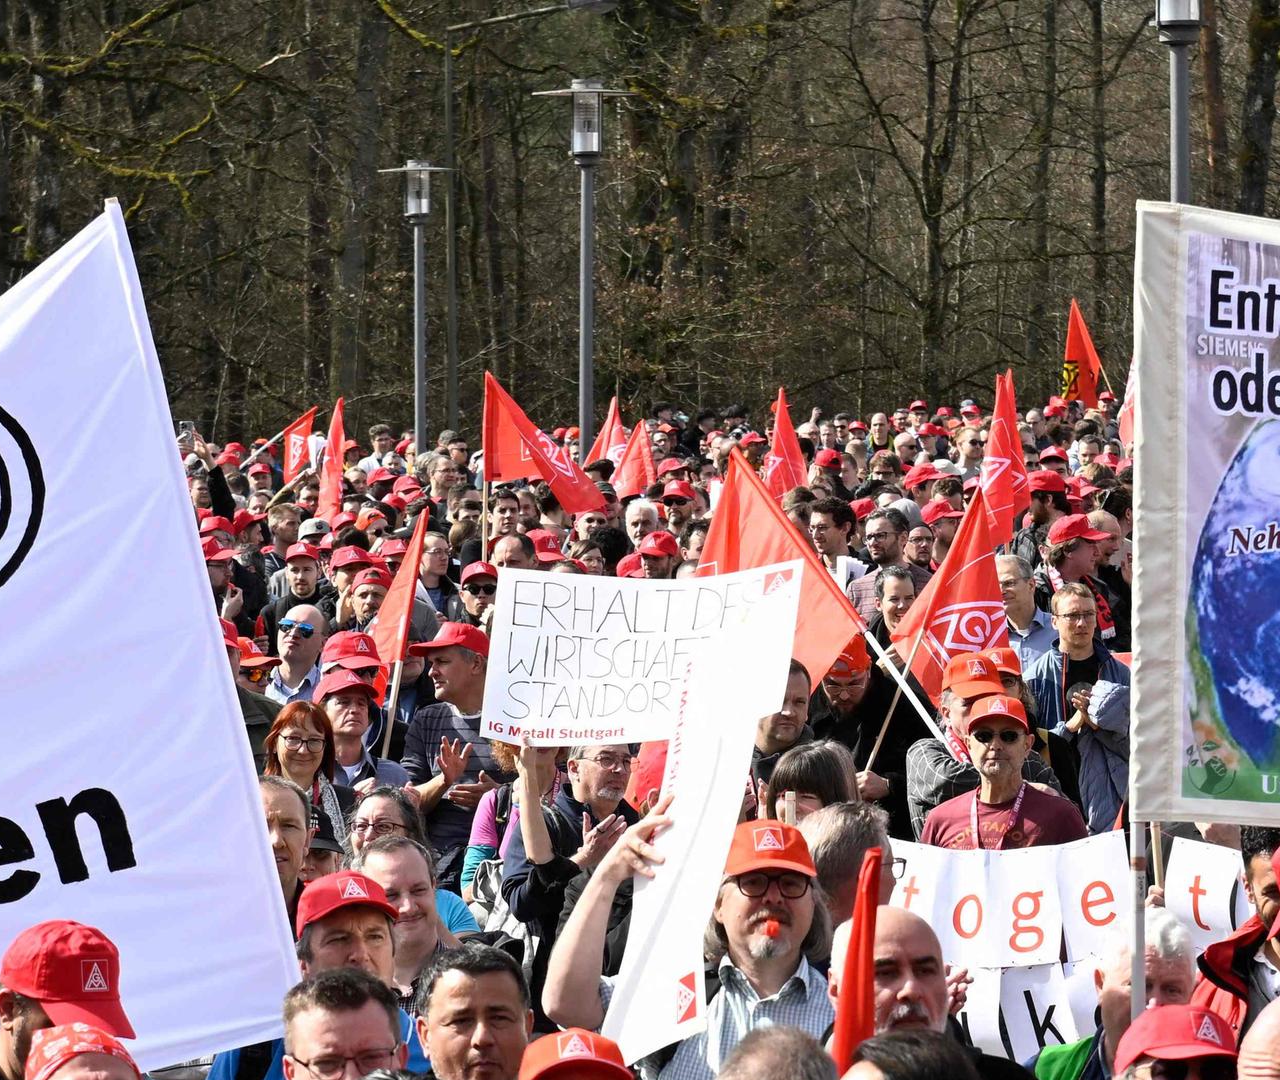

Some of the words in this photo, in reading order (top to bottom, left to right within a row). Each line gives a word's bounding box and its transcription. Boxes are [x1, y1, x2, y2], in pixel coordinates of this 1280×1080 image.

[511, 579, 688, 634] ERHALT
[488, 720, 504, 734] IG
[507, 722, 555, 739] Metall
[559, 726, 626, 740] Stuttgart
